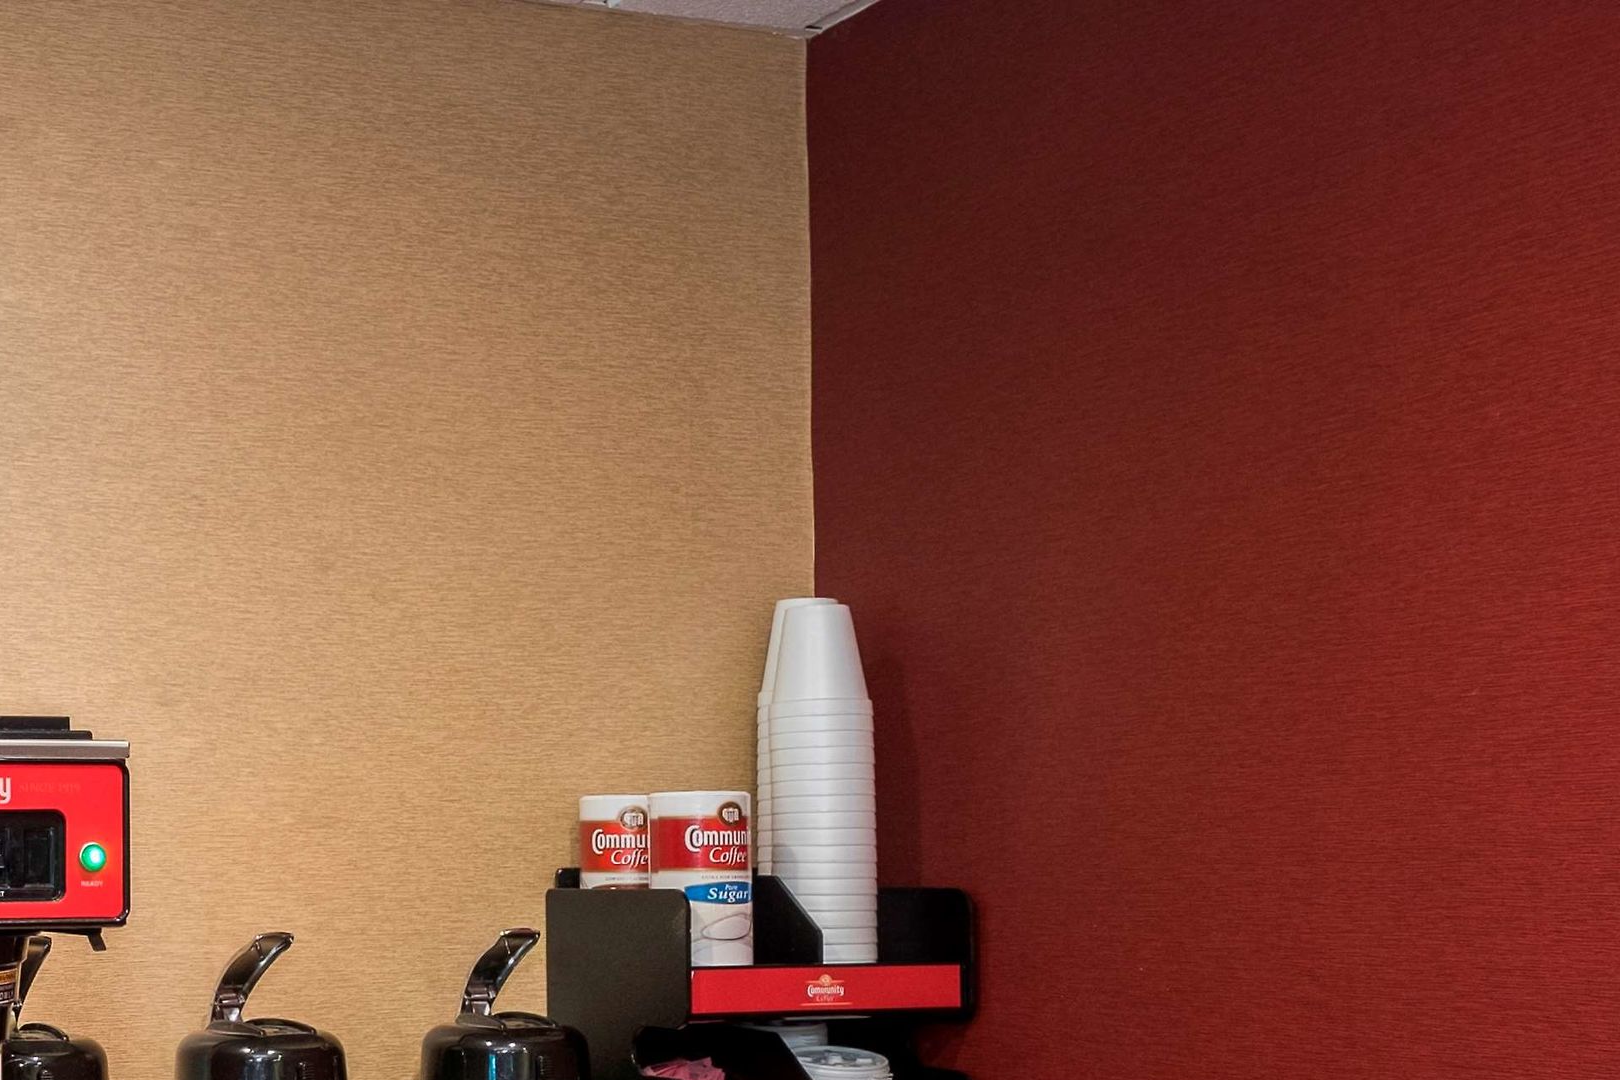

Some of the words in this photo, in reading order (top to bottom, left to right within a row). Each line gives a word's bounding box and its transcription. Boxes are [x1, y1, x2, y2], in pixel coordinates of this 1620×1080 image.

[592, 828, 649, 855] Commu
[709, 846, 747, 868] Coffee
[707, 887, 749, 902] Sugar
[807, 984, 845, 998] Community
